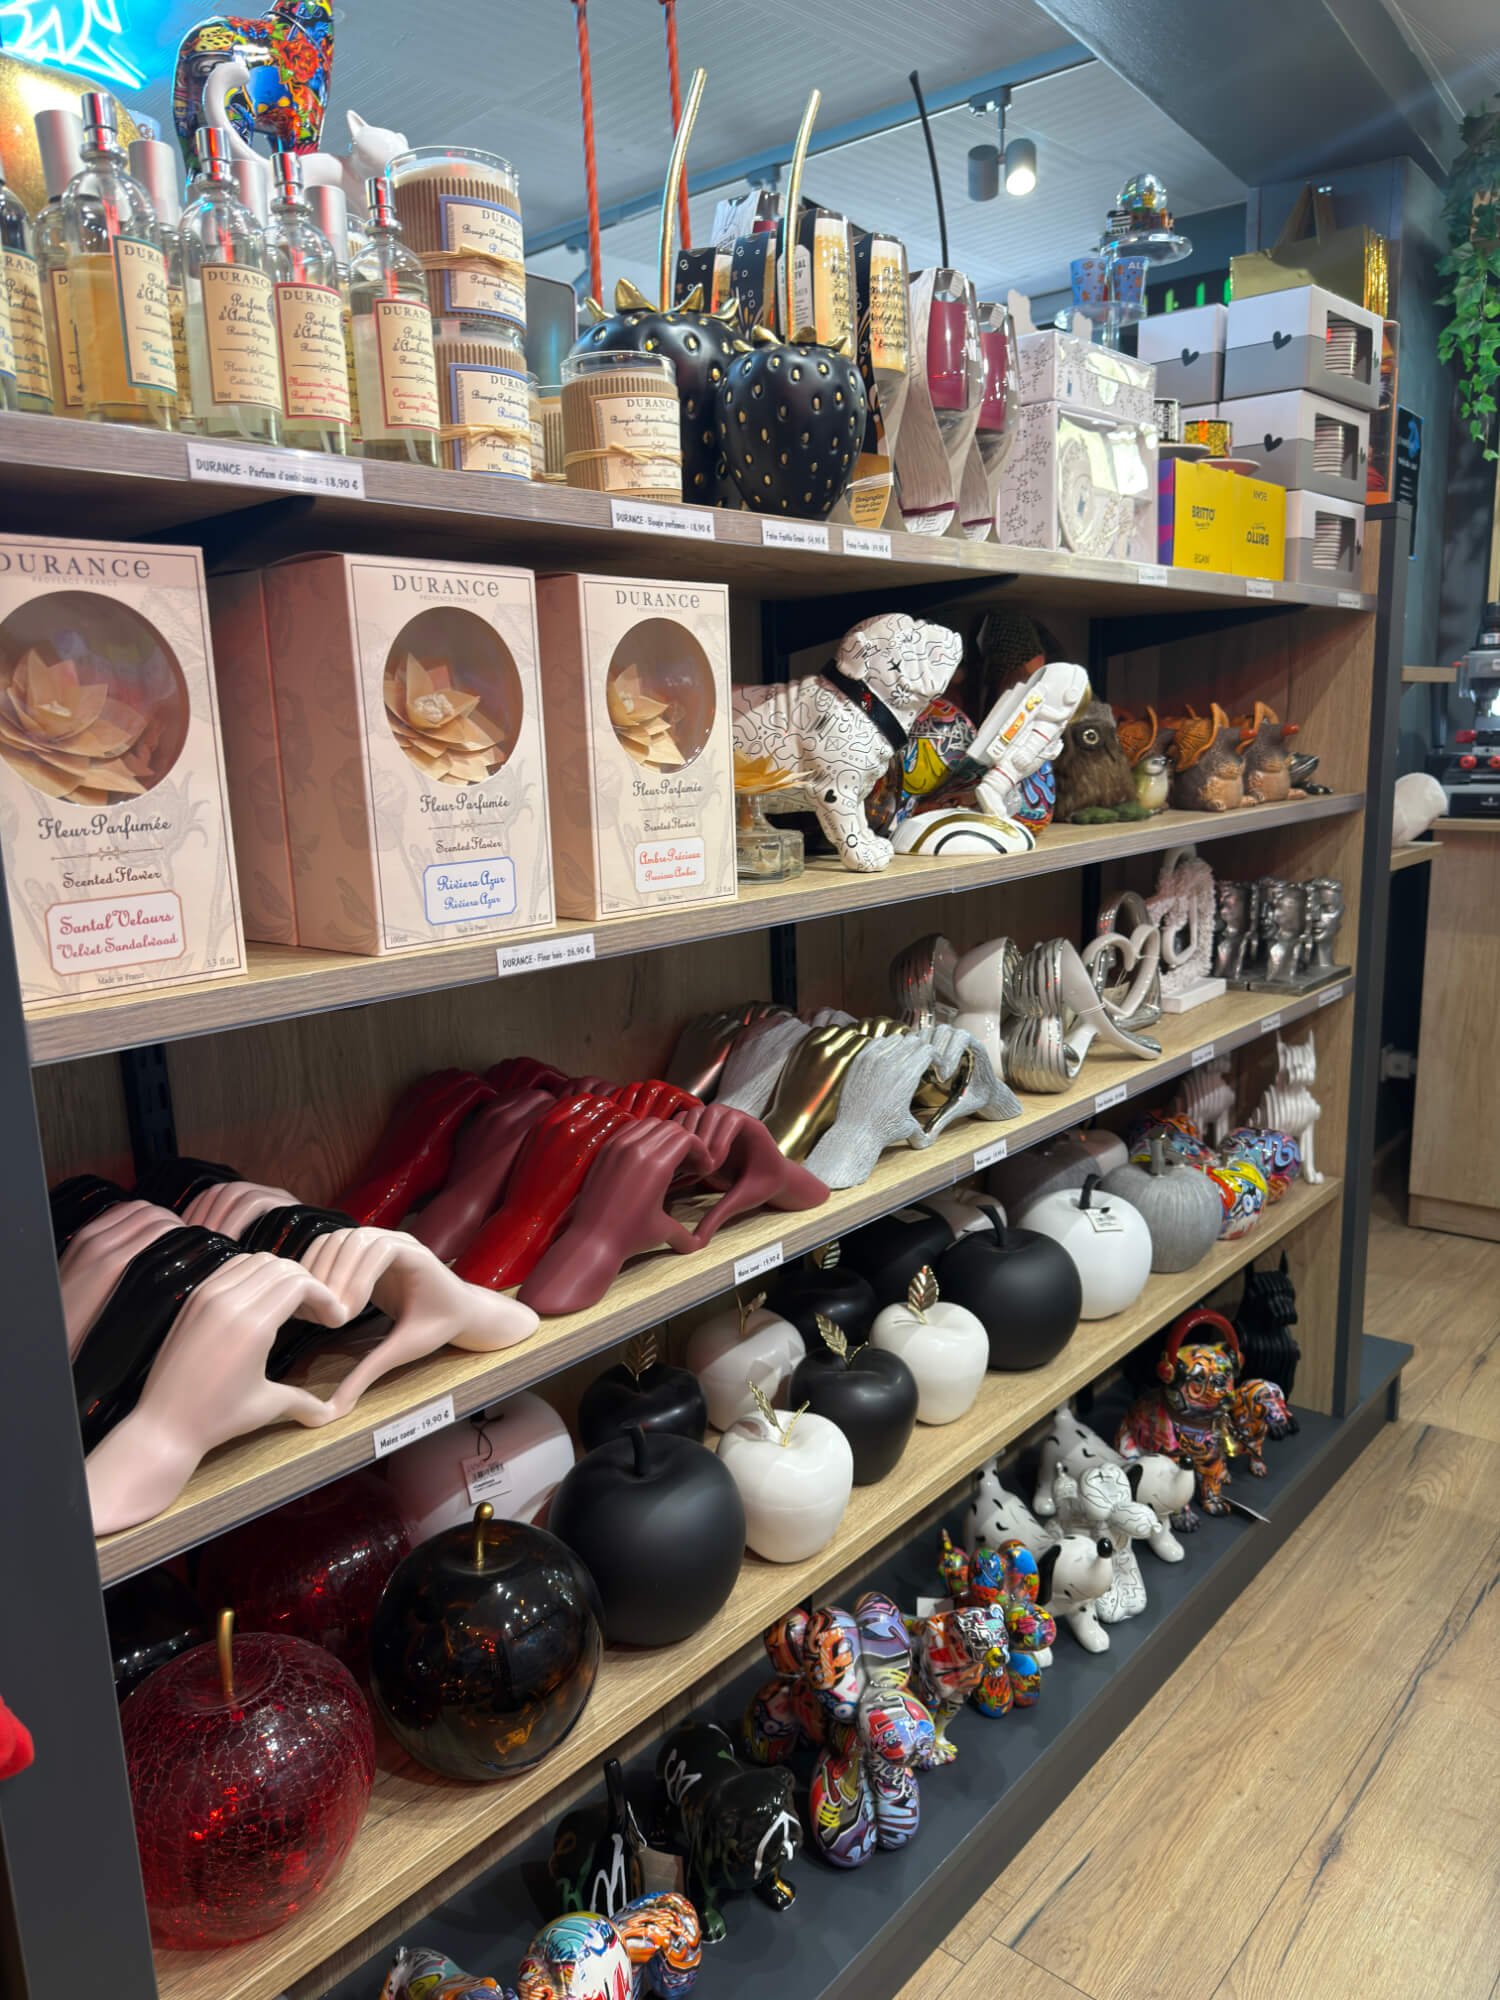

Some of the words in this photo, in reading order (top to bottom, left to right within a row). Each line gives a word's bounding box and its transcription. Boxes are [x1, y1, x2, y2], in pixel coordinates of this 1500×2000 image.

[124, 245, 161, 264] DURA
[195, 459, 241, 476] DURANCE
[249, 466, 276, 480] Parfum
[325, 477, 350, 489] 18,90
[616, 512, 644, 525] DURANCE
[1192, 505, 1216, 521] BRITTO
[1246, 530, 1269, 546] BRITTO
[632, 780, 660, 796] Fleur
[660, 779, 703, 798] Parfumée
[420, 794, 457, 813] Fleur
[456, 792, 510, 814] Parfumée
[38, 817, 91, 840] Fleur
[91, 813, 171, 840] Parfumée
[435, 840, 471, 853] Scented
[471, 836, 503, 851] Flower
[63, 872, 115, 888] Scented
[114, 866, 162, 883] Flower
[437, 875, 479, 891] Riviera
[480, 870, 506, 891] Azur
[444, 896, 479, 910] Riviera
[480, 892, 501, 909] Azur
[60, 912, 114, 935] Santal
[112, 908, 174, 927] Velours
[56, 943, 102, 960] Velvet
[103, 932, 178, 953] Sandalwood
[502, 954, 532, 969] DURANCE
[380, 1435, 399, 1449] Mains
[400, 1427, 417, 1441] coeur
[422, 1413, 442, 1430] 19,90
